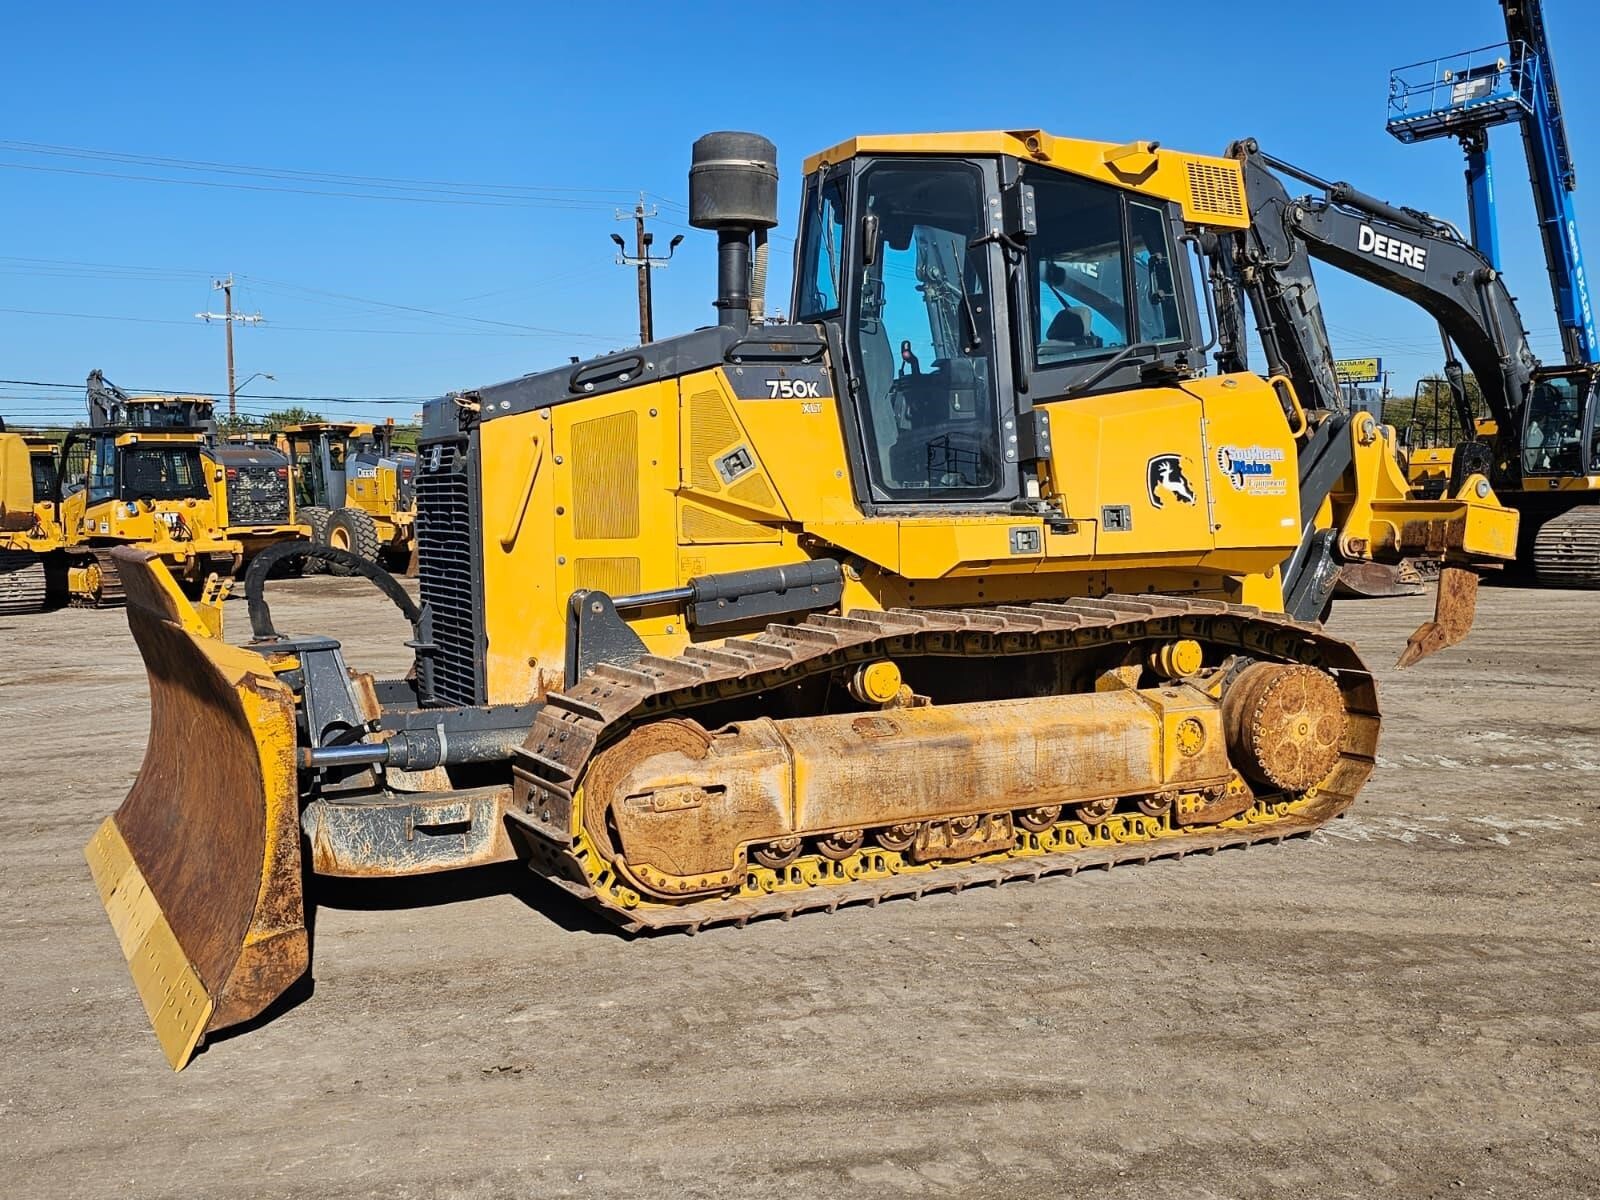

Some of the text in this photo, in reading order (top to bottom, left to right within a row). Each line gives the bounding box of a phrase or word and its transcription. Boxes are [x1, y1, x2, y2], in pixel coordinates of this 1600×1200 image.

[1358, 224, 1426, 270] DEERE
[766, 380, 820, 398] 750K
[803, 403, 822, 413] XLT
[1228, 446, 1283, 460] Southern
[1232, 460, 1272, 474] Plains
